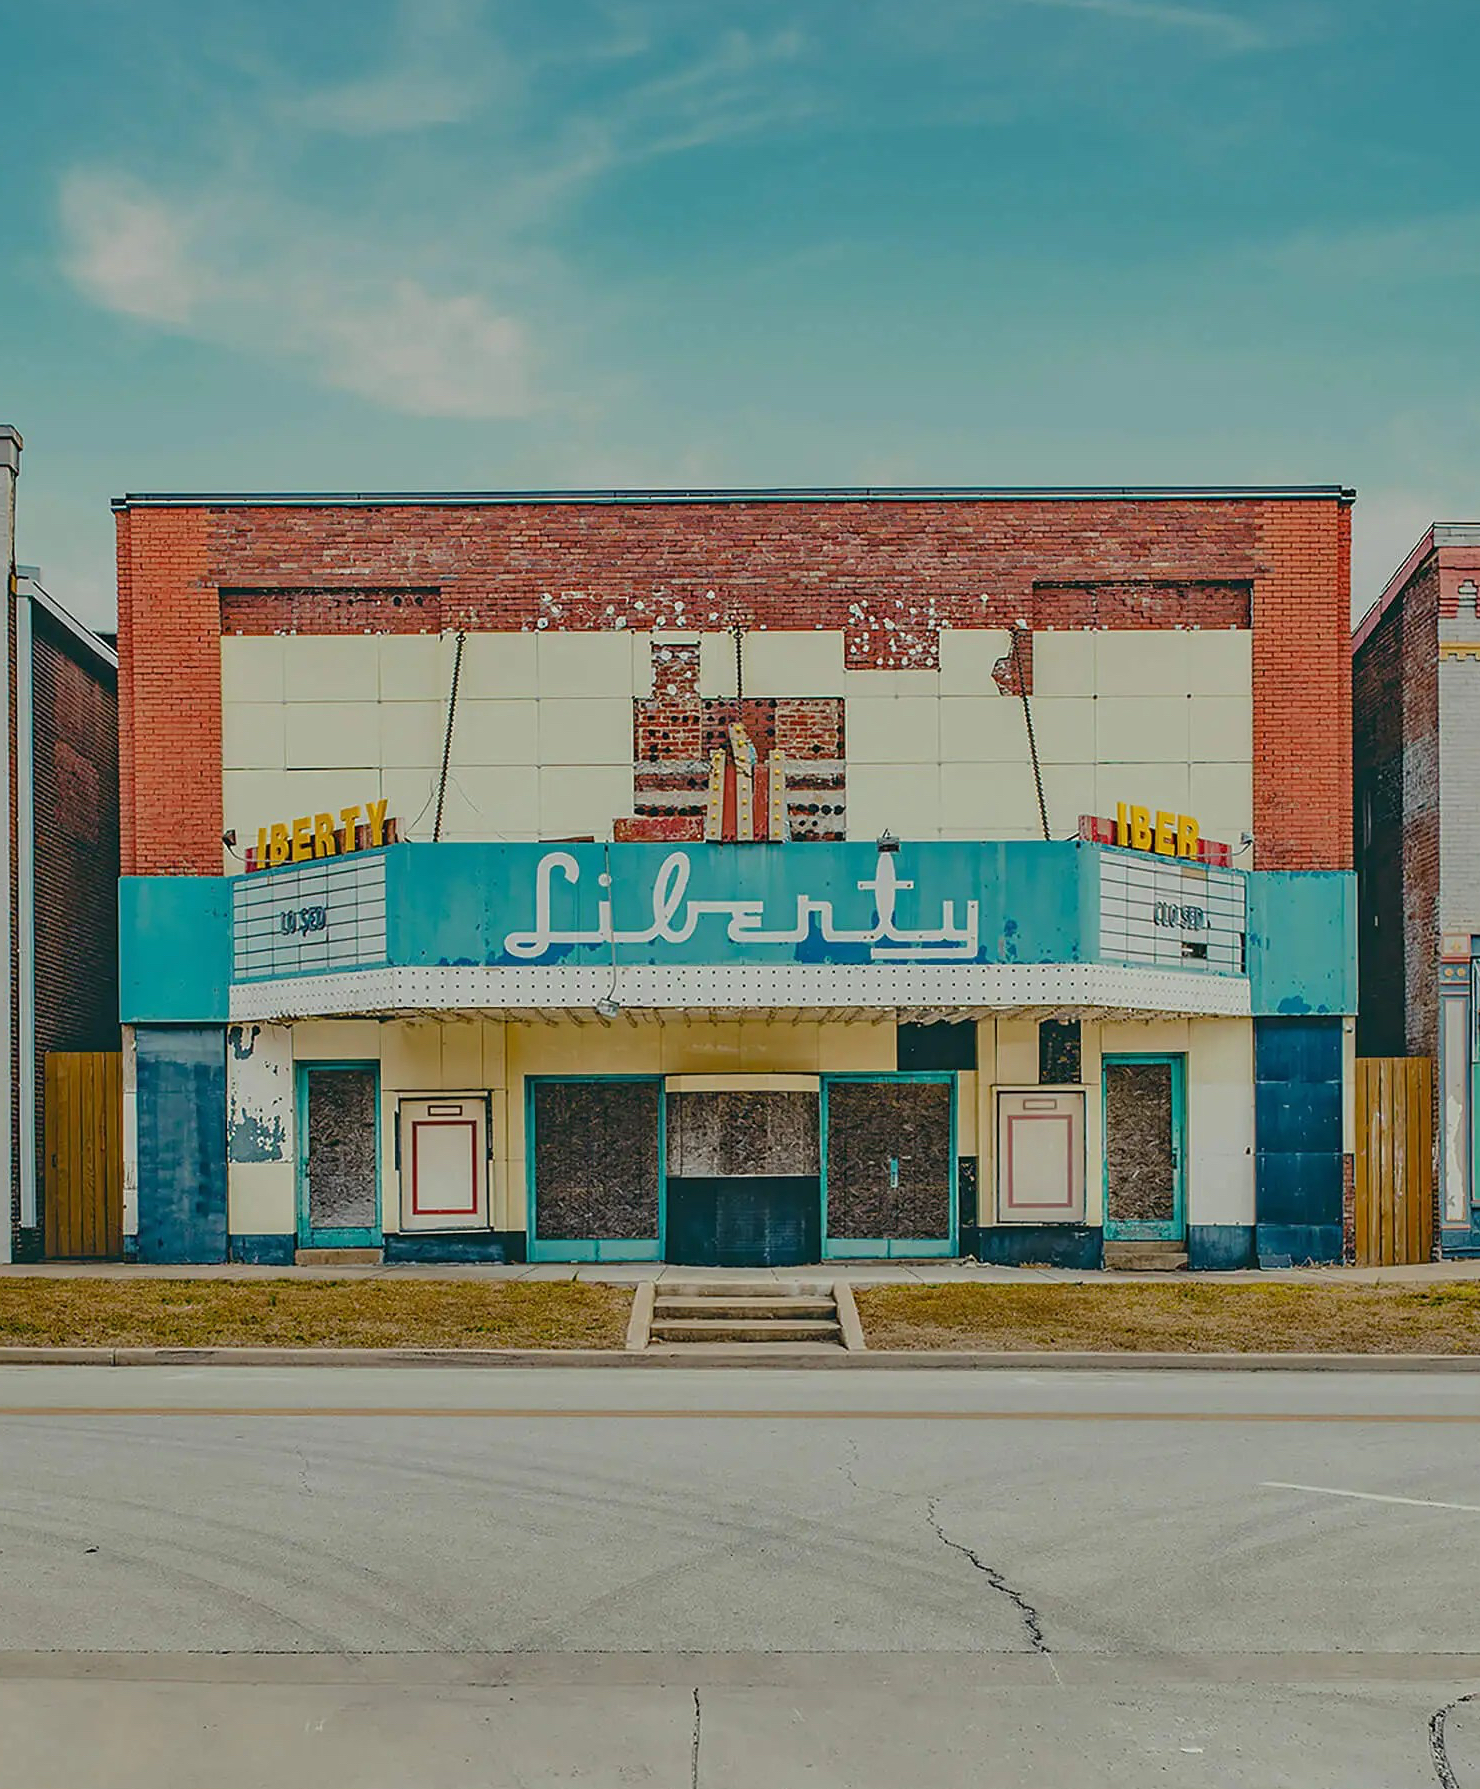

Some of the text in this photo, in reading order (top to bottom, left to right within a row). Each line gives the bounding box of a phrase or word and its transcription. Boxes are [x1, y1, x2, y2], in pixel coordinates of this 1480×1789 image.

[257, 798, 389, 869] IBERTY
[1116, 801, 1200, 860] IBER
[503, 851, 979, 959] Liberty
